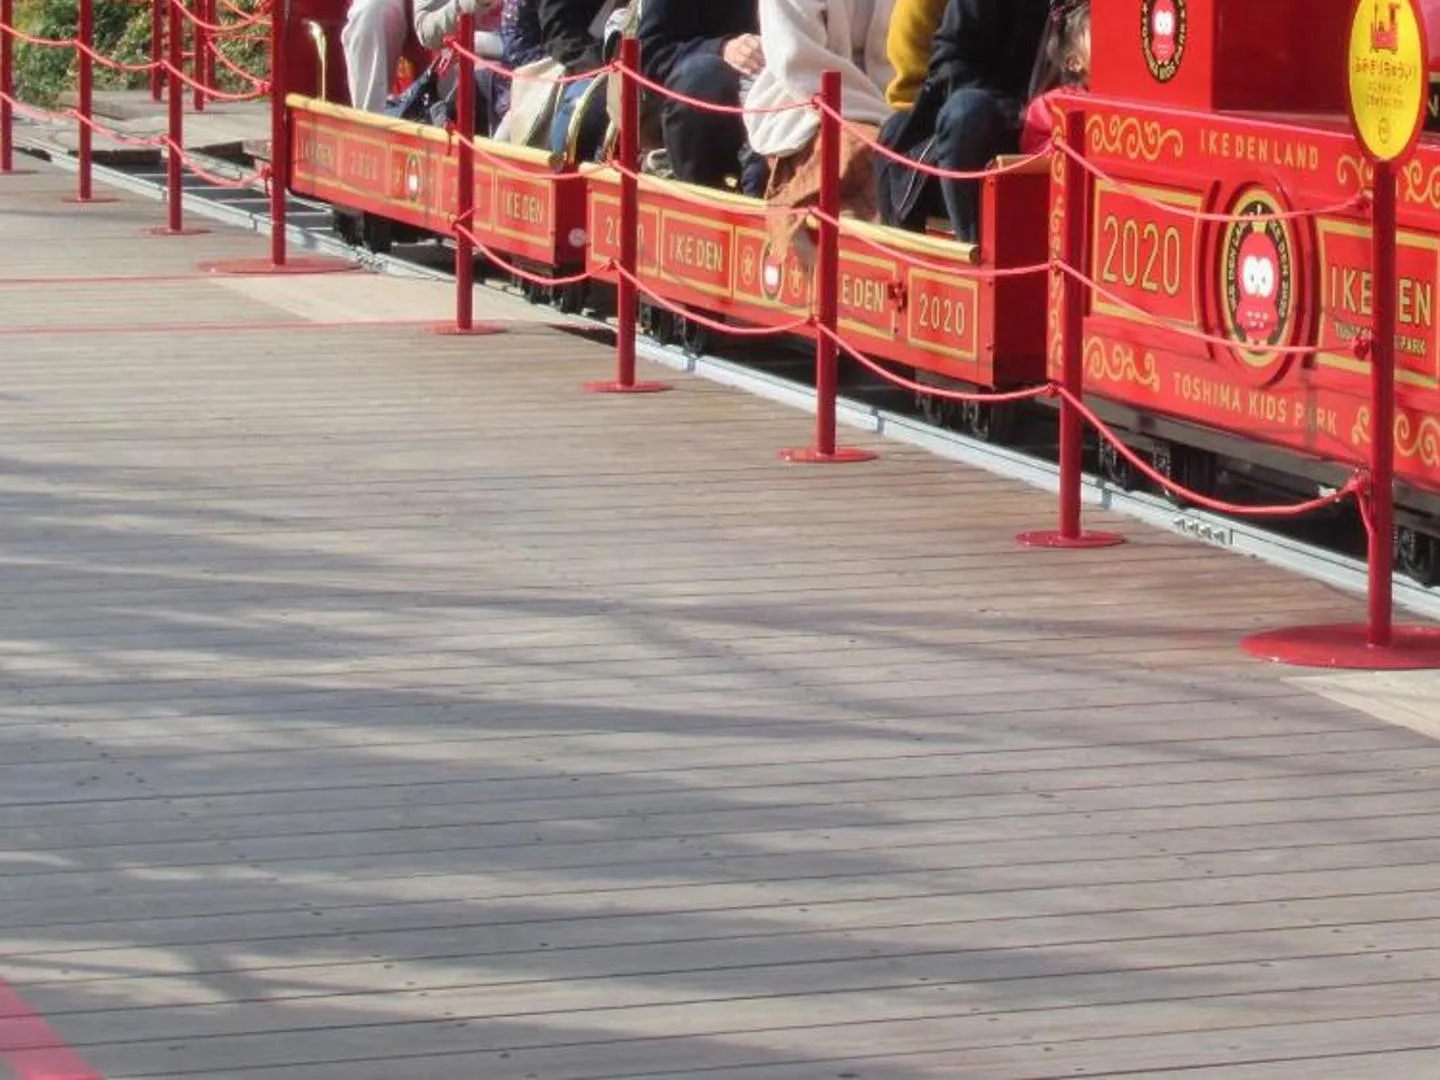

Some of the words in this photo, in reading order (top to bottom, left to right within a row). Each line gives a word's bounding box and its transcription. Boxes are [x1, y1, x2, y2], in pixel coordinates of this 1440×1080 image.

[1102, 214, 1180, 295] 2020
[919, 293, 965, 335] 2020
[1331, 265, 1432, 328] IKEEN
[1172, 371, 1242, 413] TOSHIMA
[1248, 387, 1288, 424] KIDS
